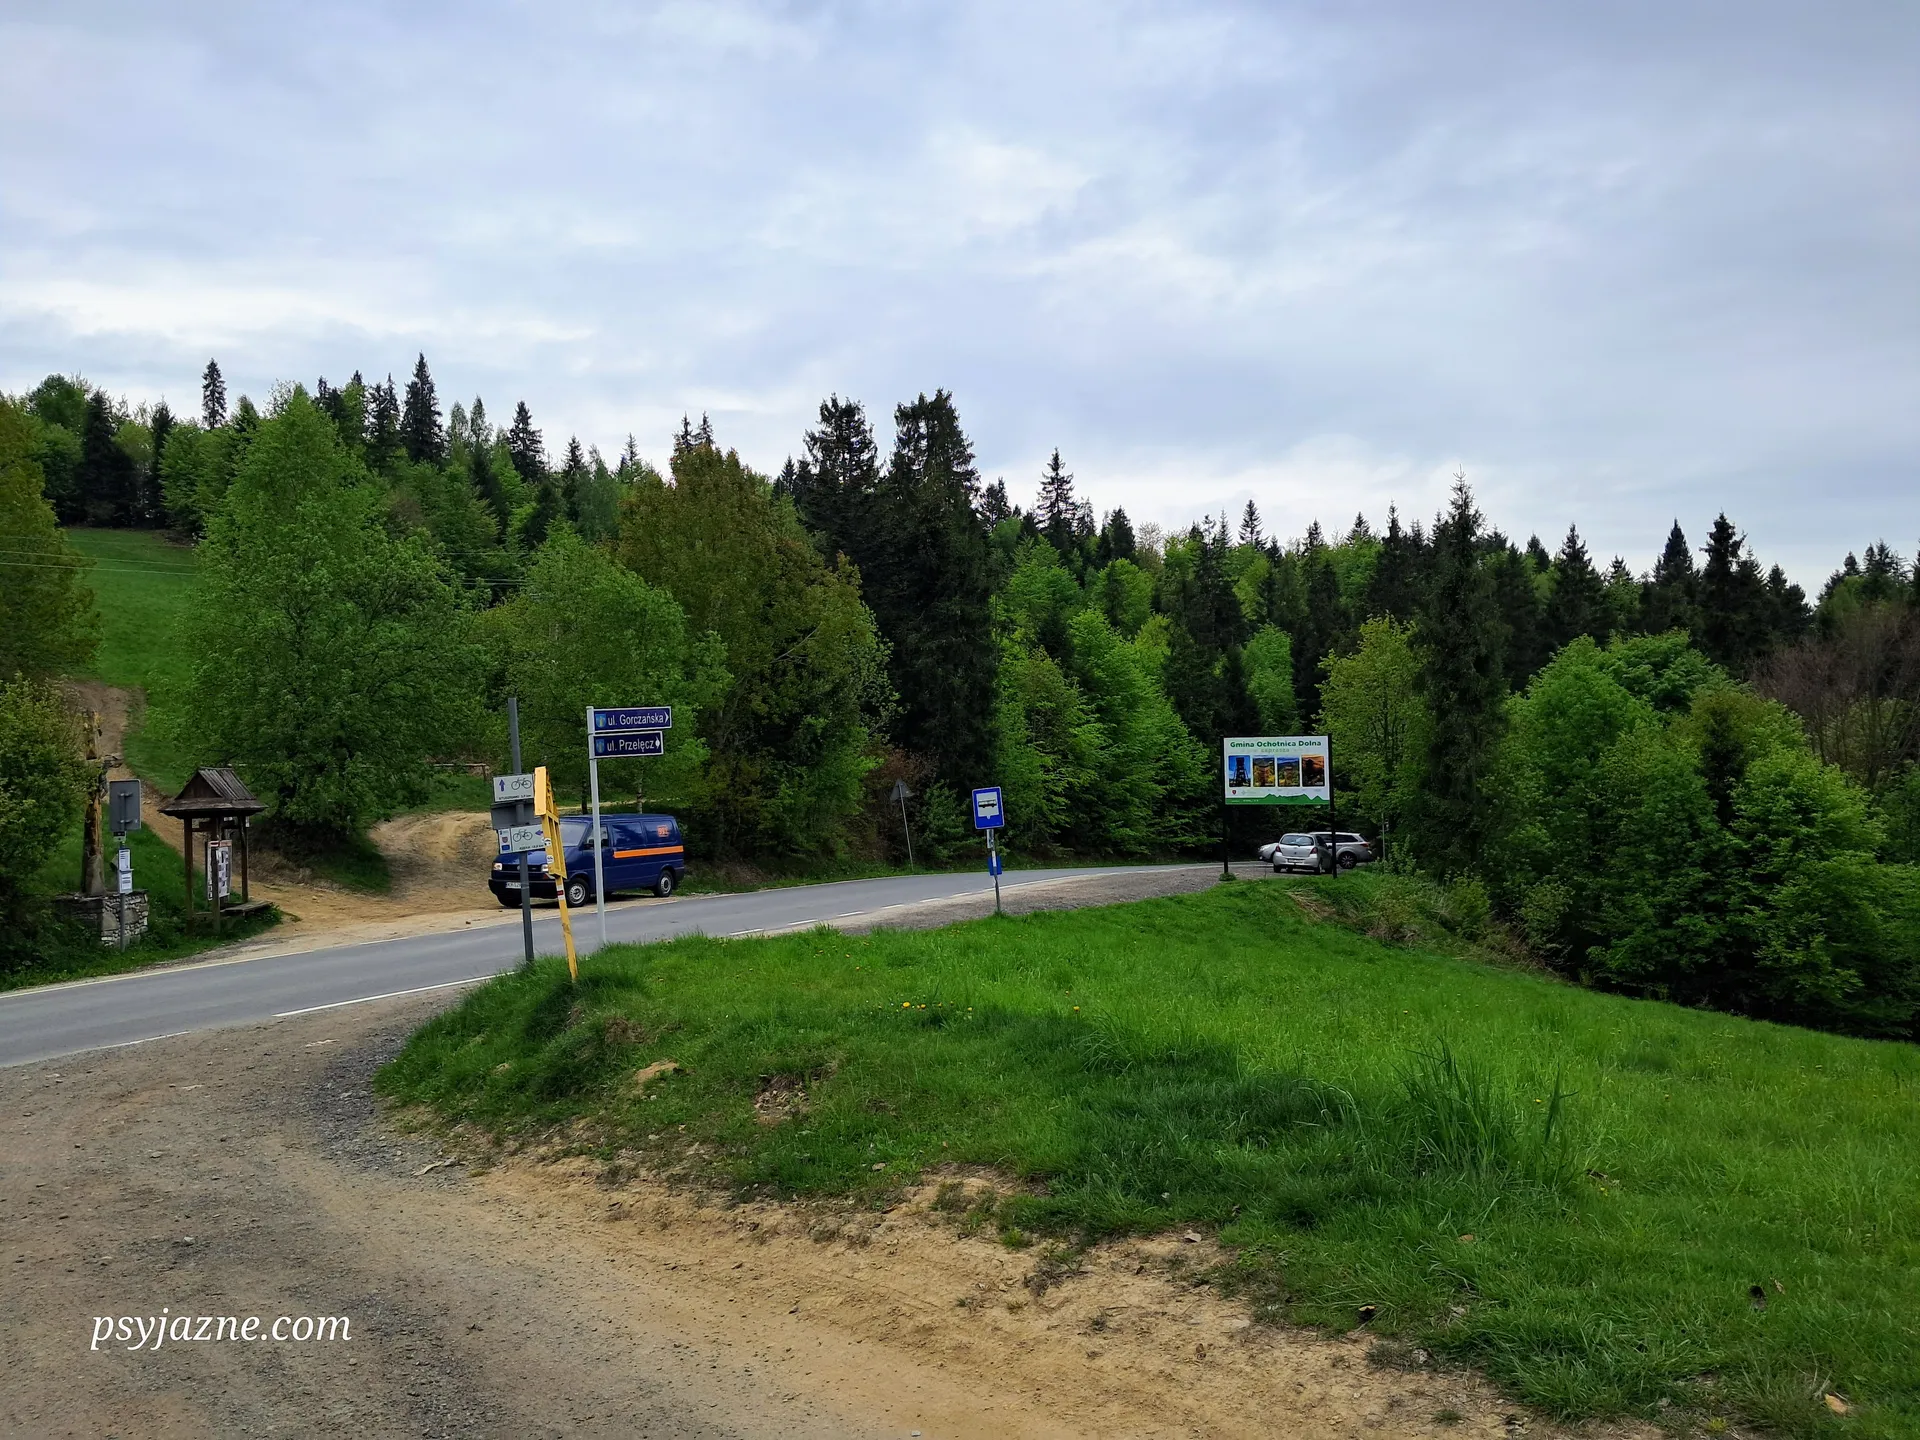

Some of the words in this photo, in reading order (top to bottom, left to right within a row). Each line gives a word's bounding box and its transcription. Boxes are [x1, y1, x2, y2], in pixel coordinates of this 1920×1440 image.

[608, 714, 617, 726] ul.
[619, 713, 664, 725] Gorczańska
[607, 739, 617, 752] ul.
[1257, 740, 1296, 748] Ochotnica
